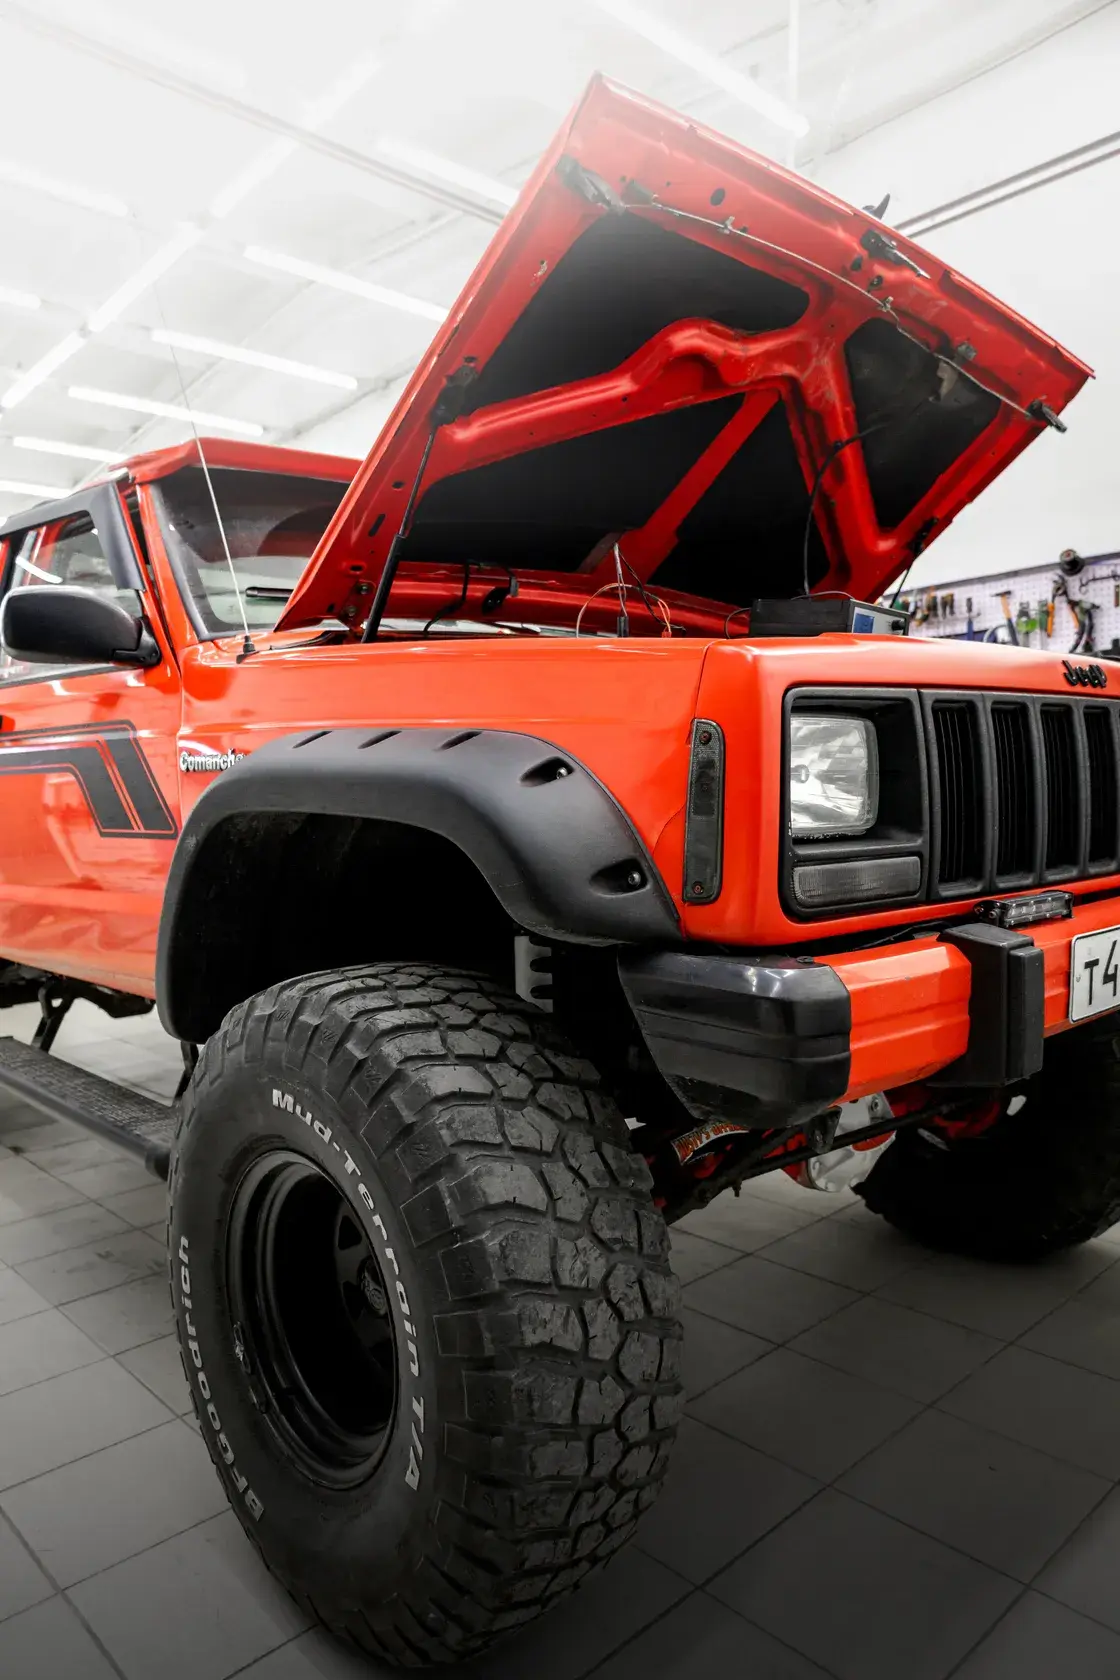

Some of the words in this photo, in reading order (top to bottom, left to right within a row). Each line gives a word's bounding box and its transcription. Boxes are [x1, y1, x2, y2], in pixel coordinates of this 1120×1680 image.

[1061, 660, 1107, 689] Jeep
[1084, 940, 1118, 1006] T4
[271, 1088, 420, 1377] Mud-Terrain
[405, 1396, 425, 1491] T/A
[179, 1236, 265, 1521] BFGoodrich
